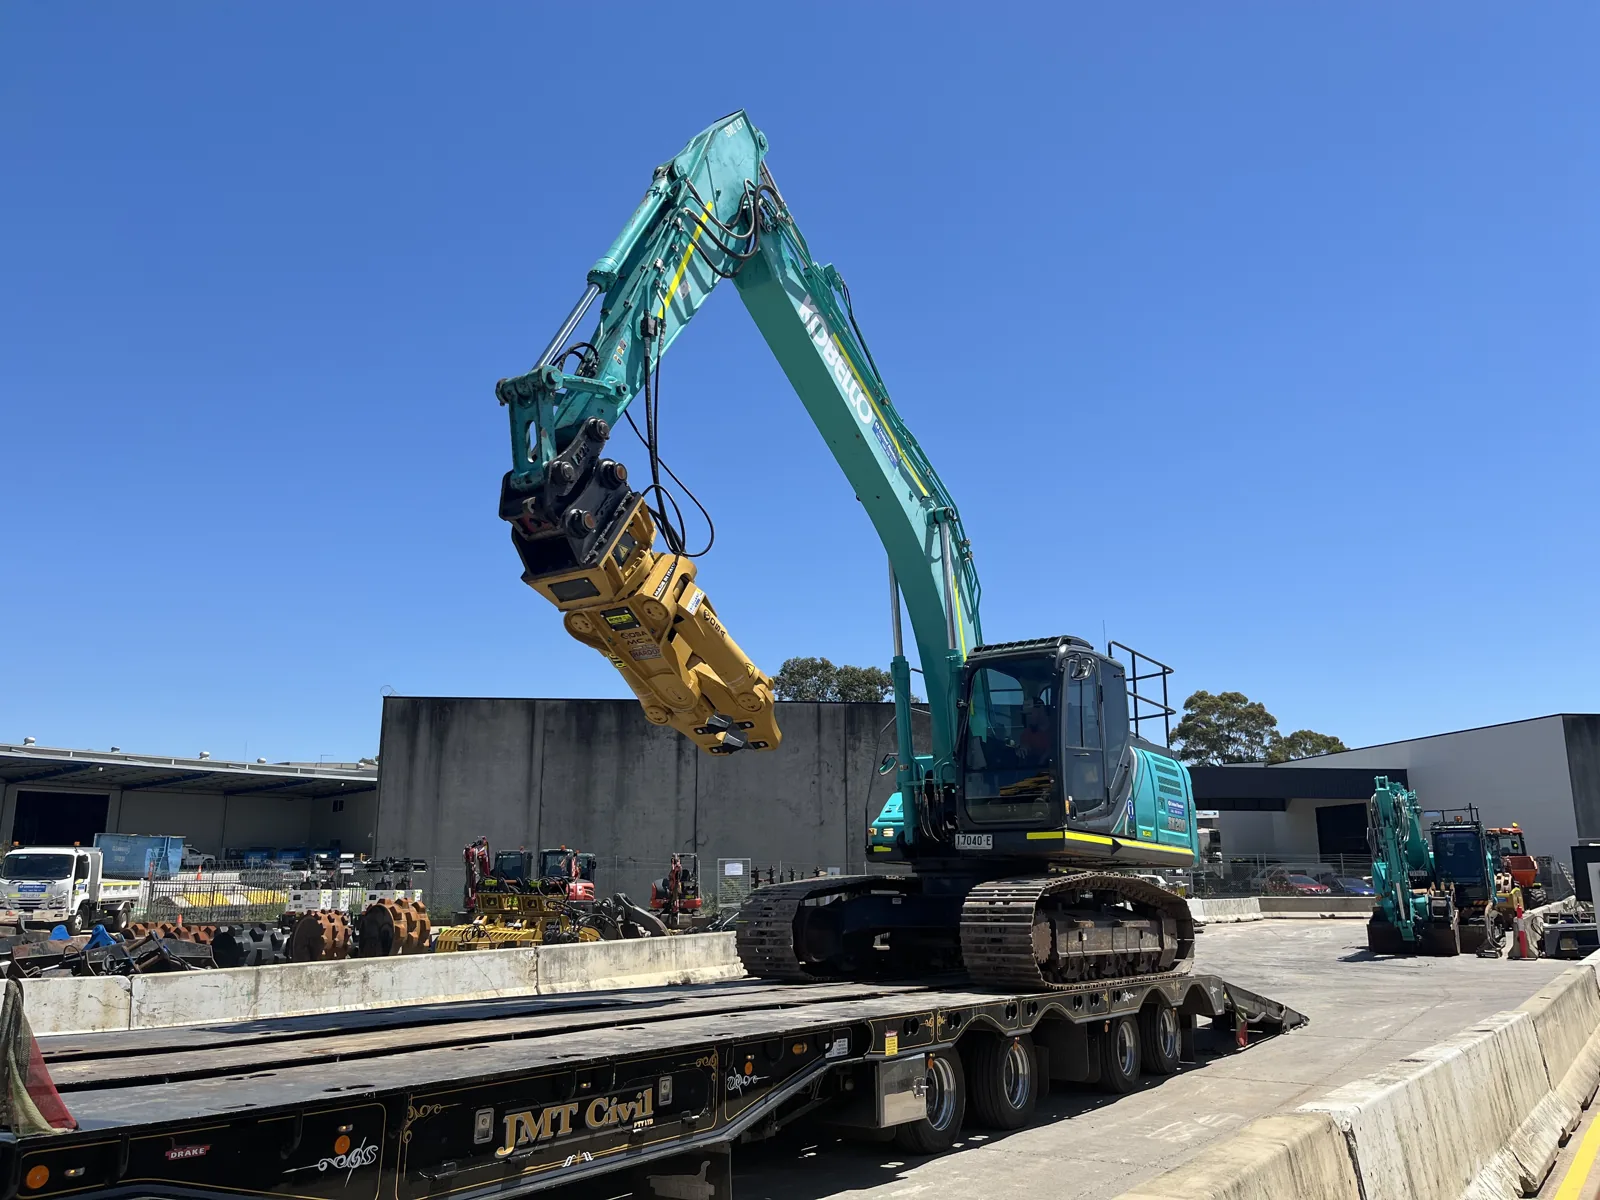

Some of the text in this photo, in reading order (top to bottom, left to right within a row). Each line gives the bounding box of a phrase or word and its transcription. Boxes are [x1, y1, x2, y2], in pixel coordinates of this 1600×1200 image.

[798, 294, 873, 424] KOBELCO
[654, 580, 665, 597] MADE
[494, 1087, 654, 1159] JMT Civil
[170, 1147, 205, 1159] DRAKE
